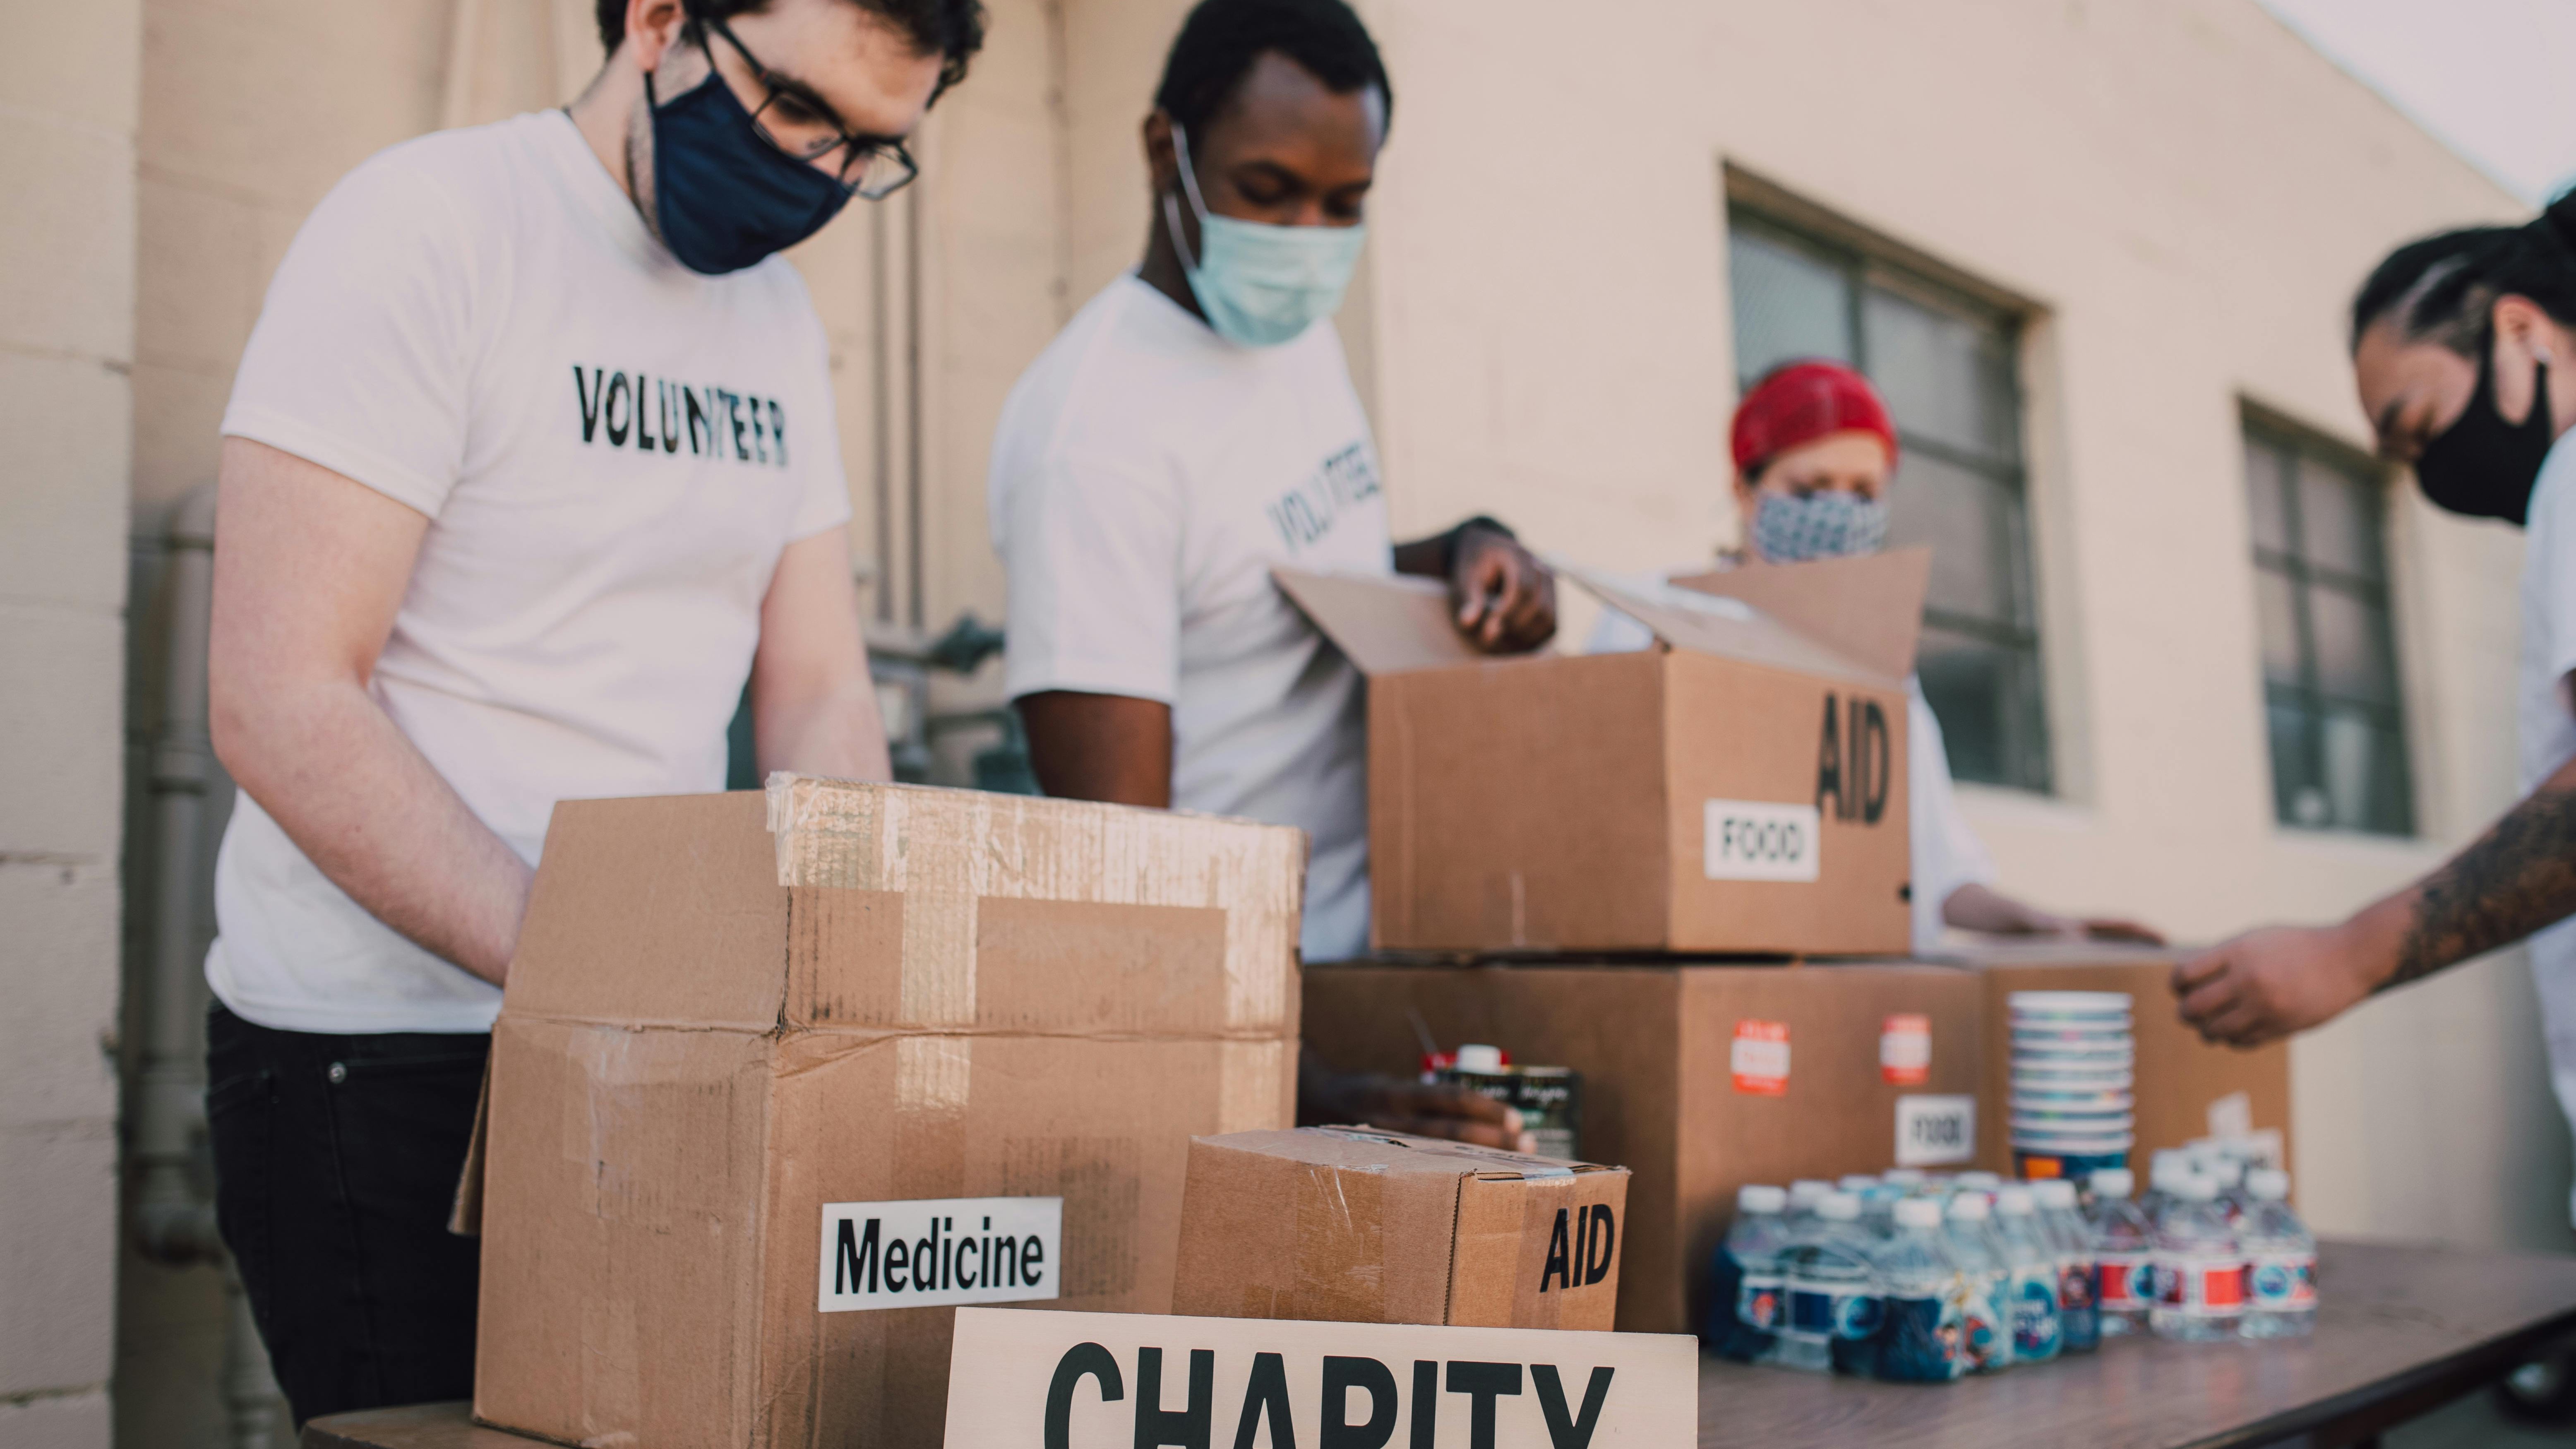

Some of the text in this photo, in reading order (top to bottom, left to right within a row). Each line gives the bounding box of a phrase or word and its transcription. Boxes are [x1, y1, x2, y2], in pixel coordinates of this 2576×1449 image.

[574, 366, 788, 466] VOLUNTEER
[1815, 690, 1890, 824] AID
[1722, 818, 1803, 861] FOOD
[835, 1216, 1043, 1294] Medicine
[1539, 1204, 1614, 1293] AID
